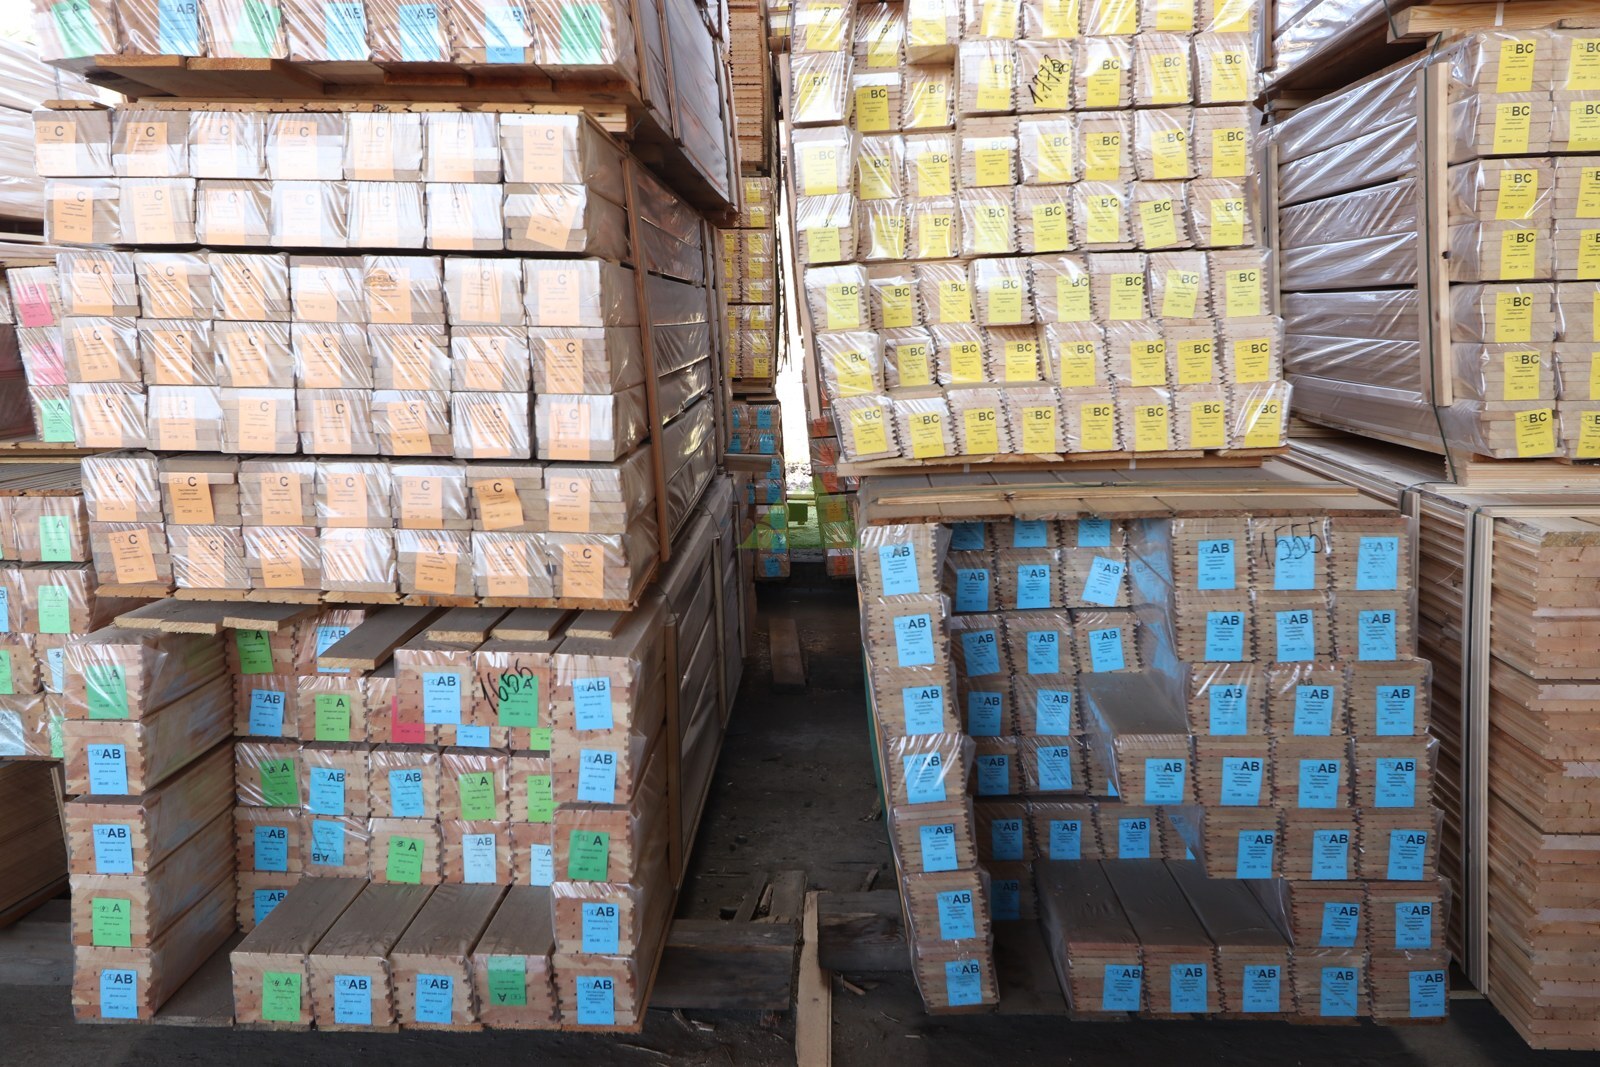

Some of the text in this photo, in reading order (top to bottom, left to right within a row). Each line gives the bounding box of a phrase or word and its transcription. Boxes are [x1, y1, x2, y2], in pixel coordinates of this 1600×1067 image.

[177, 3, 195, 14] AB
[1516, 43, 1533, 54] BC
[1102, 60, 1119, 70] BC
[1163, 57, 1180, 68] BC
[1225, 55, 1241, 65] BC
[871, 89, 886, 99] BC
[929, 85, 944, 94] BC
[1512, 106, 1530, 116] BC
[55, 125, 64, 137] C
[146, 126, 155, 137] C
[299, 127, 309, 136] C
[1167, 131, 1185, 141] BC
[1102, 136, 1119, 146] BC
[1227, 131, 1244, 142] BC
[1053, 137, 1069, 147] BC
[874, 159, 889, 168] BC
[932, 155, 948, 164] BC
[1514, 173, 1532, 183] BC
[76, 191, 86, 203] C
[1101, 198, 1118, 208] BC
[1154, 201, 1171, 213] BC
[1225, 201, 1242, 212] BC
[988, 208, 1005, 218] BC
[1045, 206, 1061, 216] BC
[934, 217, 949, 226] BC
[1517, 233, 1534, 243] BC
[92, 264, 101, 275] C
[165, 266, 175, 277] C
[1125, 276, 1141, 286] BC
[1181, 274, 1198, 285] BC
[1239, 272, 1255, 282] BC
[841, 286, 858, 295] BC
[894, 288, 910, 297] BC
[951, 283, 965, 292] BC
[1513, 296, 1531, 307] BC
[93, 330, 101, 341] C
[175, 334, 184, 345] C
[566, 342, 575, 353] C
[910, 347, 925, 356] BC
[962, 344, 977, 353] BC
[1017, 343, 1032, 352] BC
[1077, 344, 1093, 354] BC
[1147, 344, 1163, 354] BC
[1194, 343, 1210, 354] BC
[1251, 343, 1268, 353] BC
[850, 353, 866, 362] BC
[1521, 355, 1539, 364] BC
[57, 403, 64, 411] A
[335, 404, 344, 414] C
[1093, 407, 1109, 416] BC
[1147, 407, 1163, 417] BC
[1204, 404, 1220, 414] BC
[864, 409, 881, 420] BC
[923, 414, 939, 425] BC
[978, 411, 995, 421] BC
[1035, 410, 1051, 420] BC
[1529, 412, 1547, 423] BC
[188, 477, 197, 487] C
[280, 476, 288, 487] C
[345, 477, 355, 488] C
[421, 480, 430, 491] C
[493, 482, 503, 493] C
[569, 482, 578, 493] C
[56, 520, 65, 529] A
[128, 534, 138, 544] C
[583, 548, 592, 559] C
[892, 547, 910, 558] AB
[1210, 543, 1230, 554] AB
[1030, 569, 1046, 578] AB
[1103, 564, 1120, 574] AB
[969, 572, 985, 581] AB
[908, 618, 926, 629] AB
[1220, 615, 1239, 625] AB
[1289, 614, 1308, 624] AB
[1371, 613, 1391, 624] AB
[255, 630, 263, 640] A
[978, 634, 994, 644] AB
[1039, 634, 1055, 643] AB
[1101, 631, 1117, 640] AB
[112, 669, 120, 680] A
[437, 676, 456, 686] AB
[523, 679, 532, 690] A
[586, 681, 606, 692] AB
[921, 689, 939, 699] AB
[1223, 688, 1242, 698] AB
[1309, 689, 1329, 699] AB
[1390, 689, 1410, 698] AB
[264, 694, 280, 704] AB
[336, 698, 345, 707] A
[984, 697, 1000, 706] AB
[1053, 695, 1069, 704] AB
[102, 749, 121, 759] AB
[1053, 749, 1068, 757] AB
[593, 754, 612, 765] AB
[281, 763, 289, 772] A
[1164, 763, 1182, 773] AB
[1240, 761, 1260, 771] AB
[1318, 763, 1337, 773] AB
[1395, 762, 1414, 771] AB
[327, 772, 345, 782] AB
[404, 773, 422, 782] AB
[480, 776, 488, 786] A
[936, 826, 953, 835] AB
[1062, 823, 1077, 831] AB
[1131, 821, 1146, 830] AB
[107, 828, 126, 838] AB
[268, 829, 285, 839] AB
[477, 837, 492, 846] AB
[593, 836, 602, 846] A
[1255, 835, 1274, 844] AB
[1329, 834, 1348, 844] AB
[1406, 835, 1425, 844] AB
[408, 842, 417, 851] A
[312, 853, 329, 862] AB
[953, 894, 970, 904] AB
[112, 903, 121, 912] A
[596, 907, 615, 917] AB
[1339, 907, 1358, 916] AB
[1411, 906, 1430, 915] AB
[962, 964, 979, 974] AB
[1122, 969, 1140, 978] AB
[1185, 968, 1203, 977] AB
[1258, 969, 1276, 978] AB
[114, 974, 133, 984] AB
[1336, 971, 1354, 980] AB
[1425, 973, 1444, 983] AB
[284, 977, 293, 986] A
[349, 979, 367, 990] AB
[430, 979, 449, 989] AB
[593, 980, 612, 989] AB
[497, 993, 507, 1002] A
